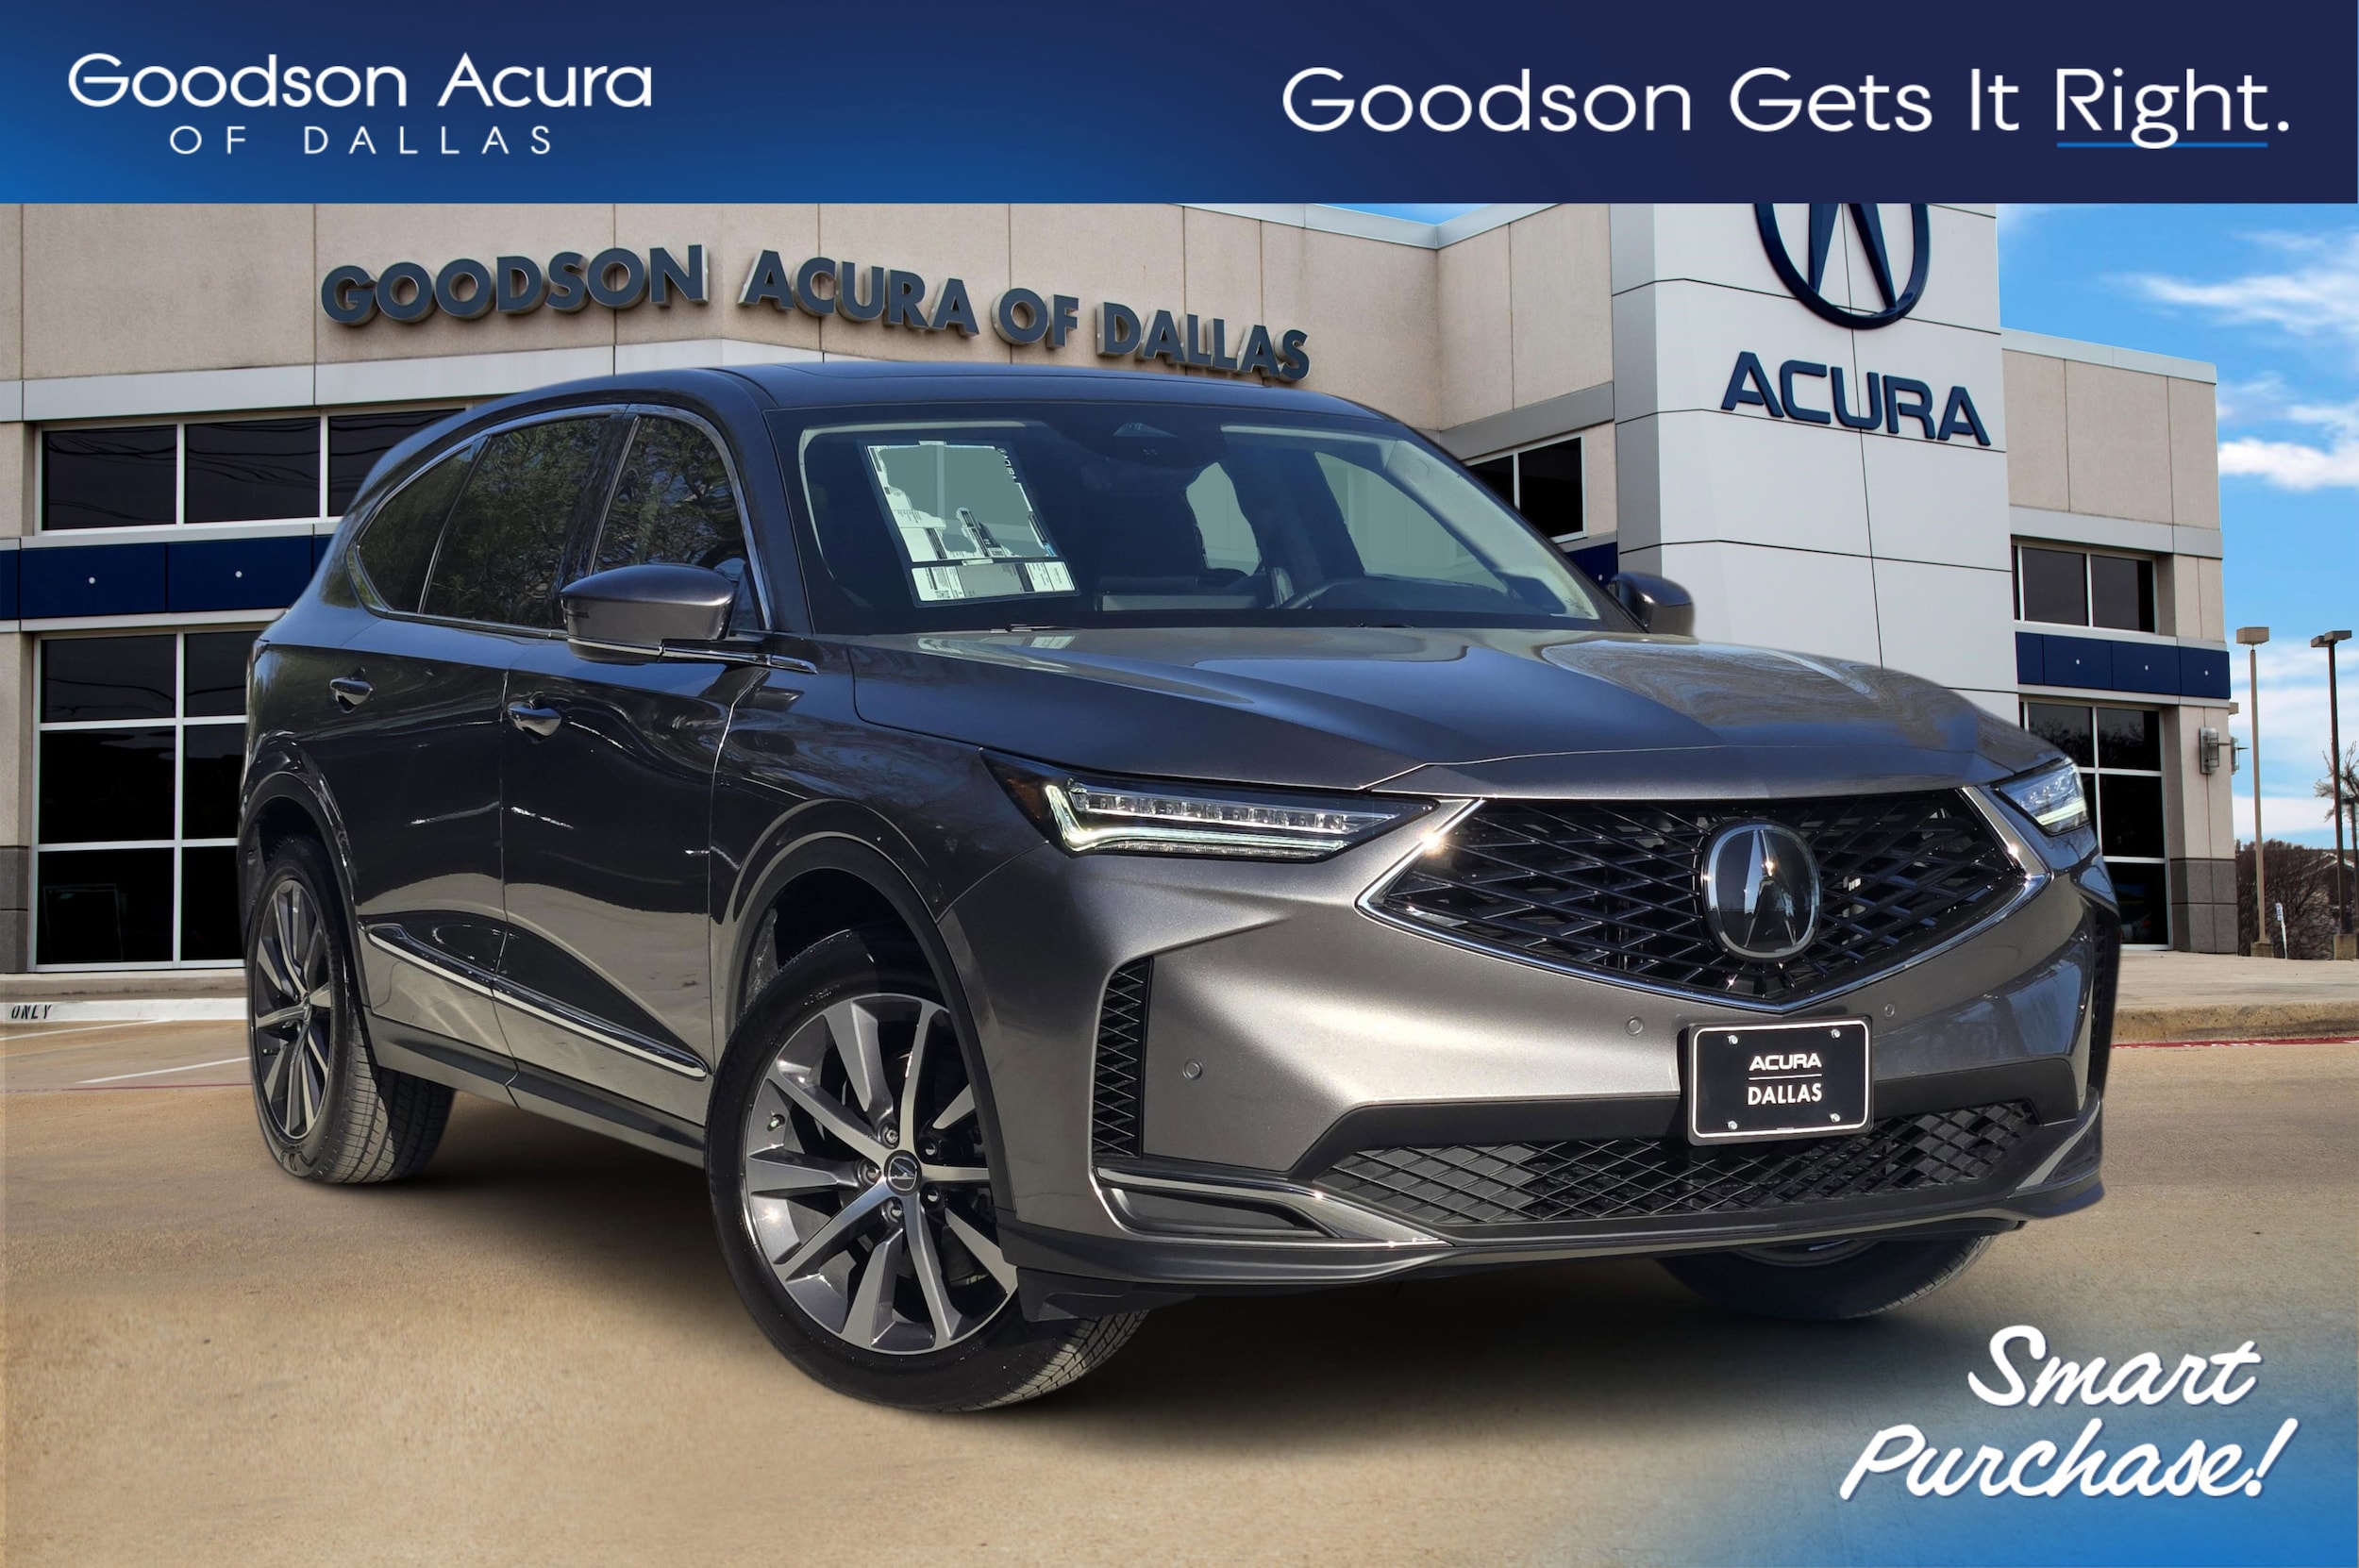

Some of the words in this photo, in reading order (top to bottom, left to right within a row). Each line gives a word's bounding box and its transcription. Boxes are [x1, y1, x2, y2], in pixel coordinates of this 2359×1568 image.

[321, 244, 709, 326] GOODSON
[739, 250, 979, 337] ACURA
[991, 287, 1079, 349] OF
[1096, 302, 1312, 381] DALLAS
[1721, 351, 1991, 446] ACURA
[11, 1004, 53, 1020] ONLY
[1748, 1053, 1822, 1072] ACURA
[1748, 1083, 1822, 1106] DALLAS
